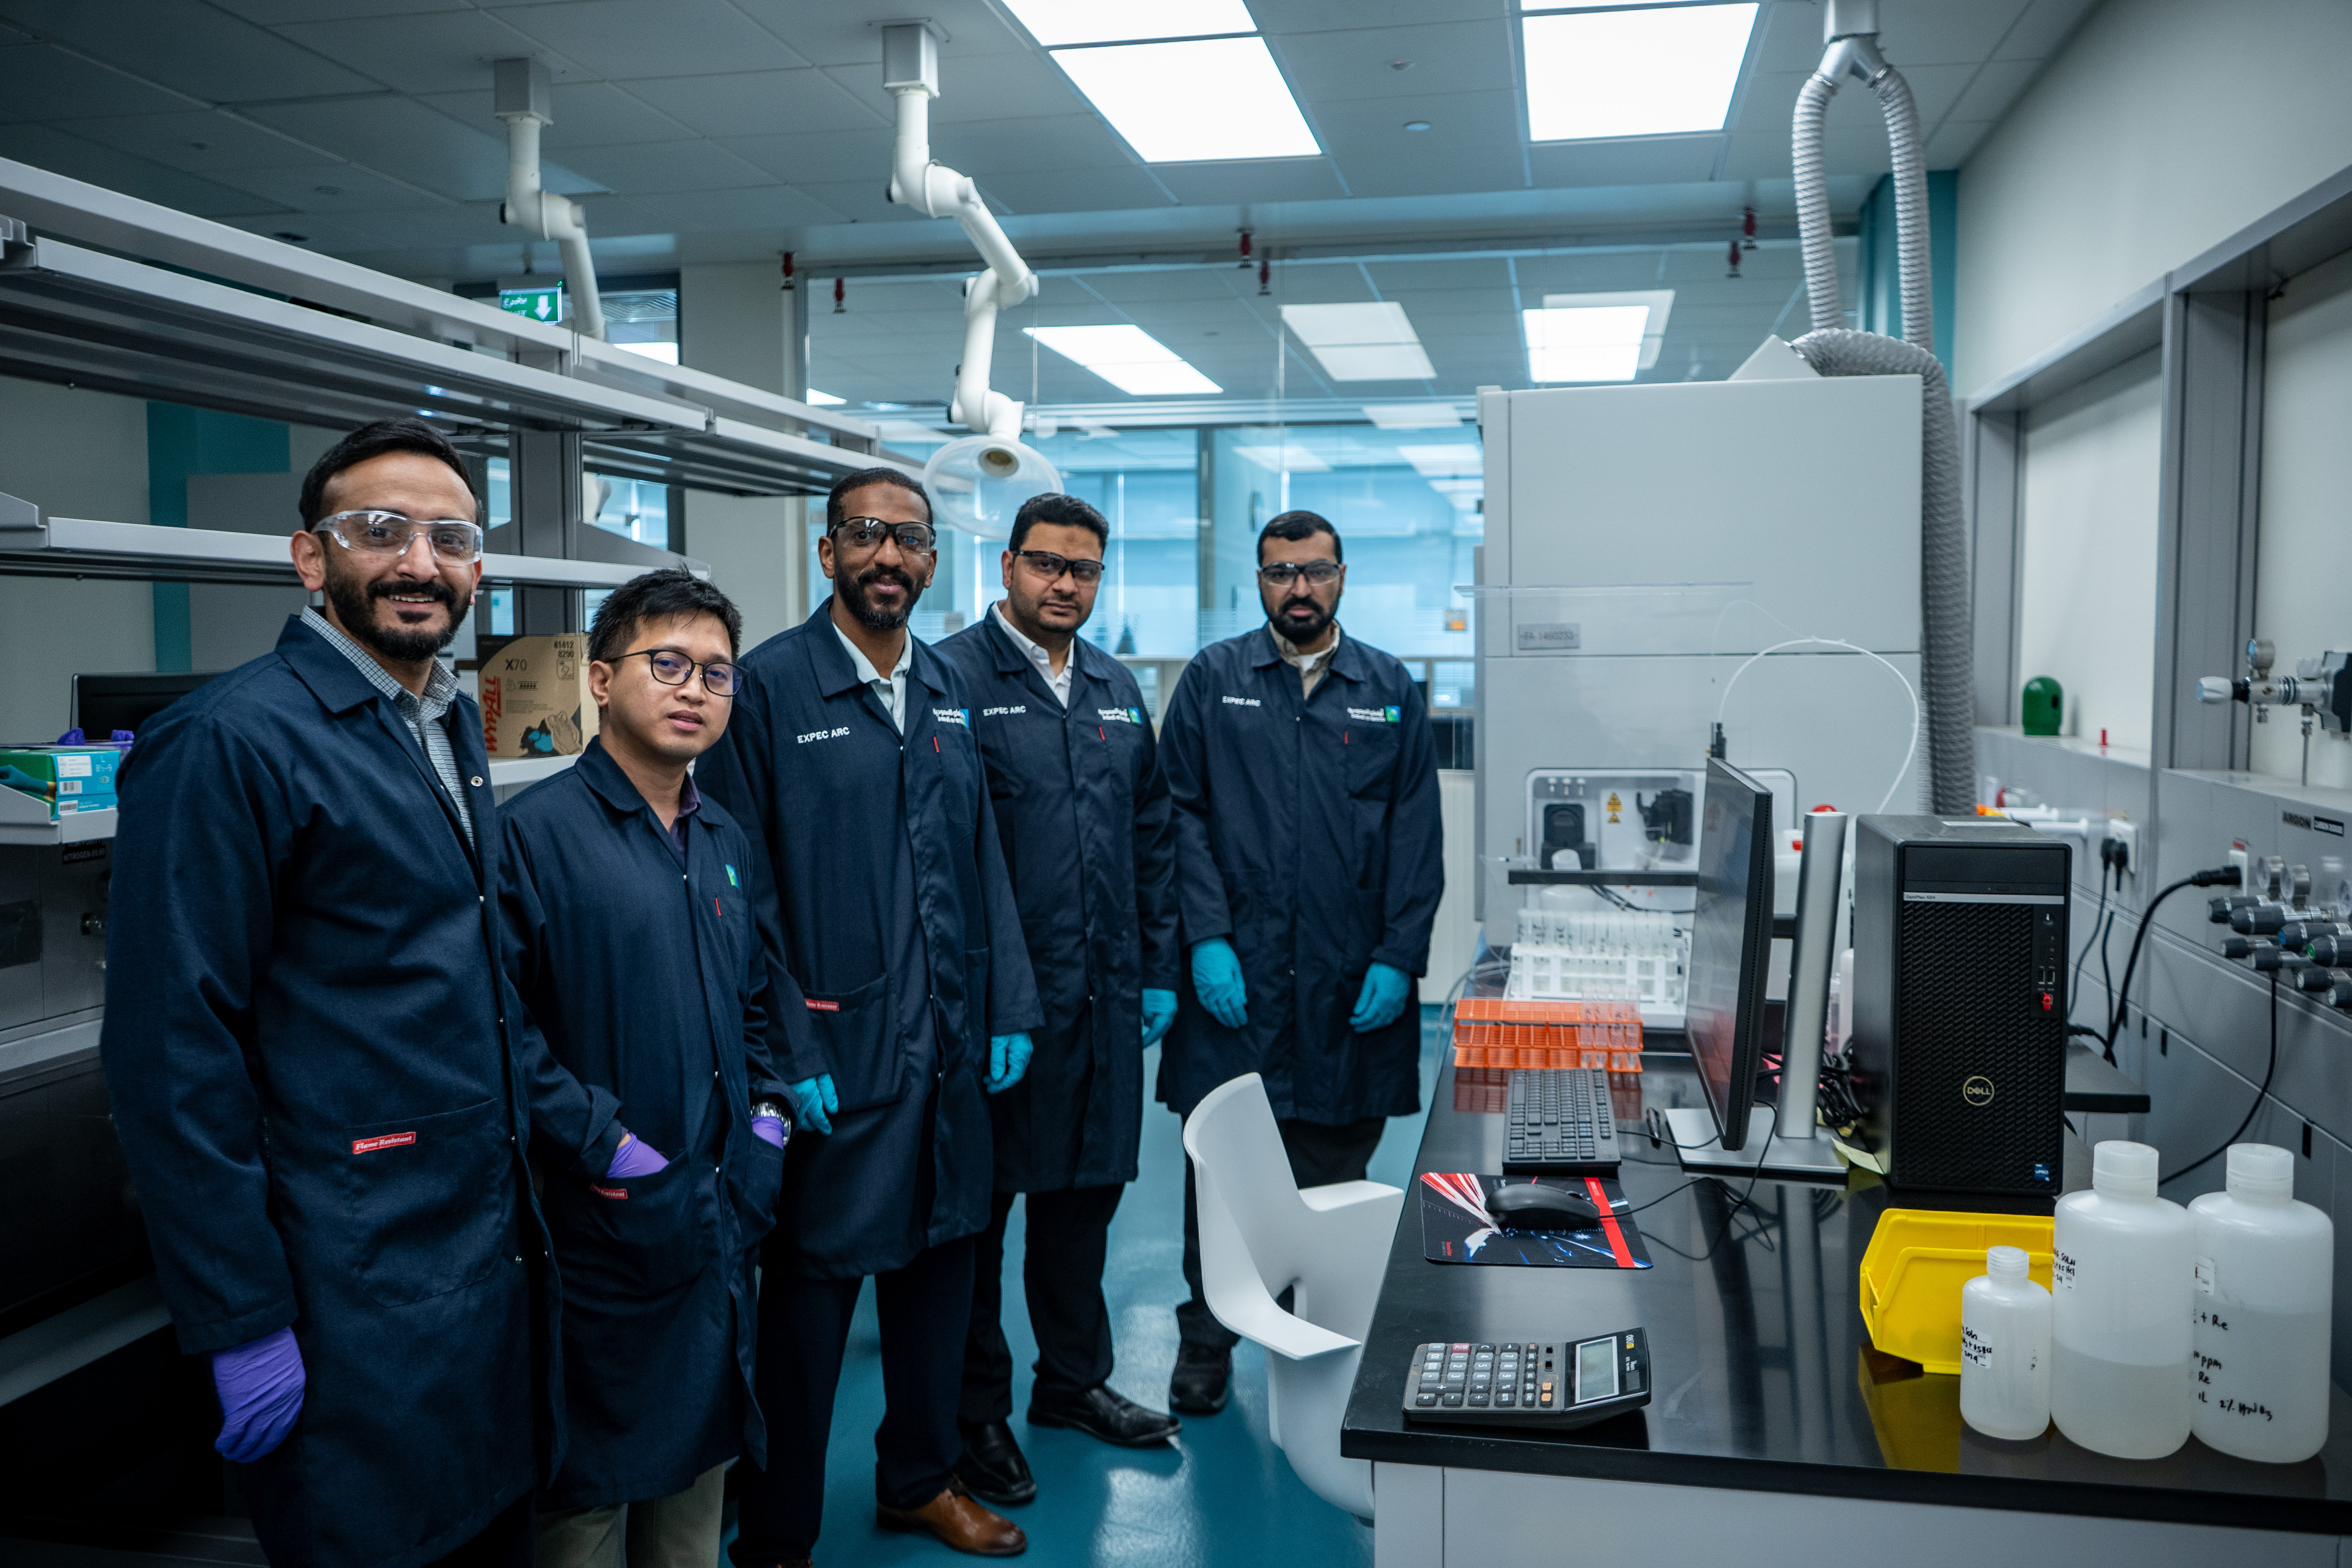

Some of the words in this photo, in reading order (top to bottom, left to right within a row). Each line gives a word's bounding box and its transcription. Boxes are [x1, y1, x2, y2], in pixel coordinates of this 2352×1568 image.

[503, 295, 527, 308] مخرج
[505, 659, 527, 671] X70
[983, 707, 1009, 717] EXPEC
[1010, 705, 1026, 714] ARC
[797, 730, 829, 744] EXPEC
[831, 727, 850, 738] ARC
[1967, 1087, 1991, 1095] DELL
[379, 1136, 412, 1145] Resistant
[2212, 1314, 2229, 1331] Re
[2201, 1356, 2221, 1370] ppm
[2199, 1371, 2211, 1384] Re
